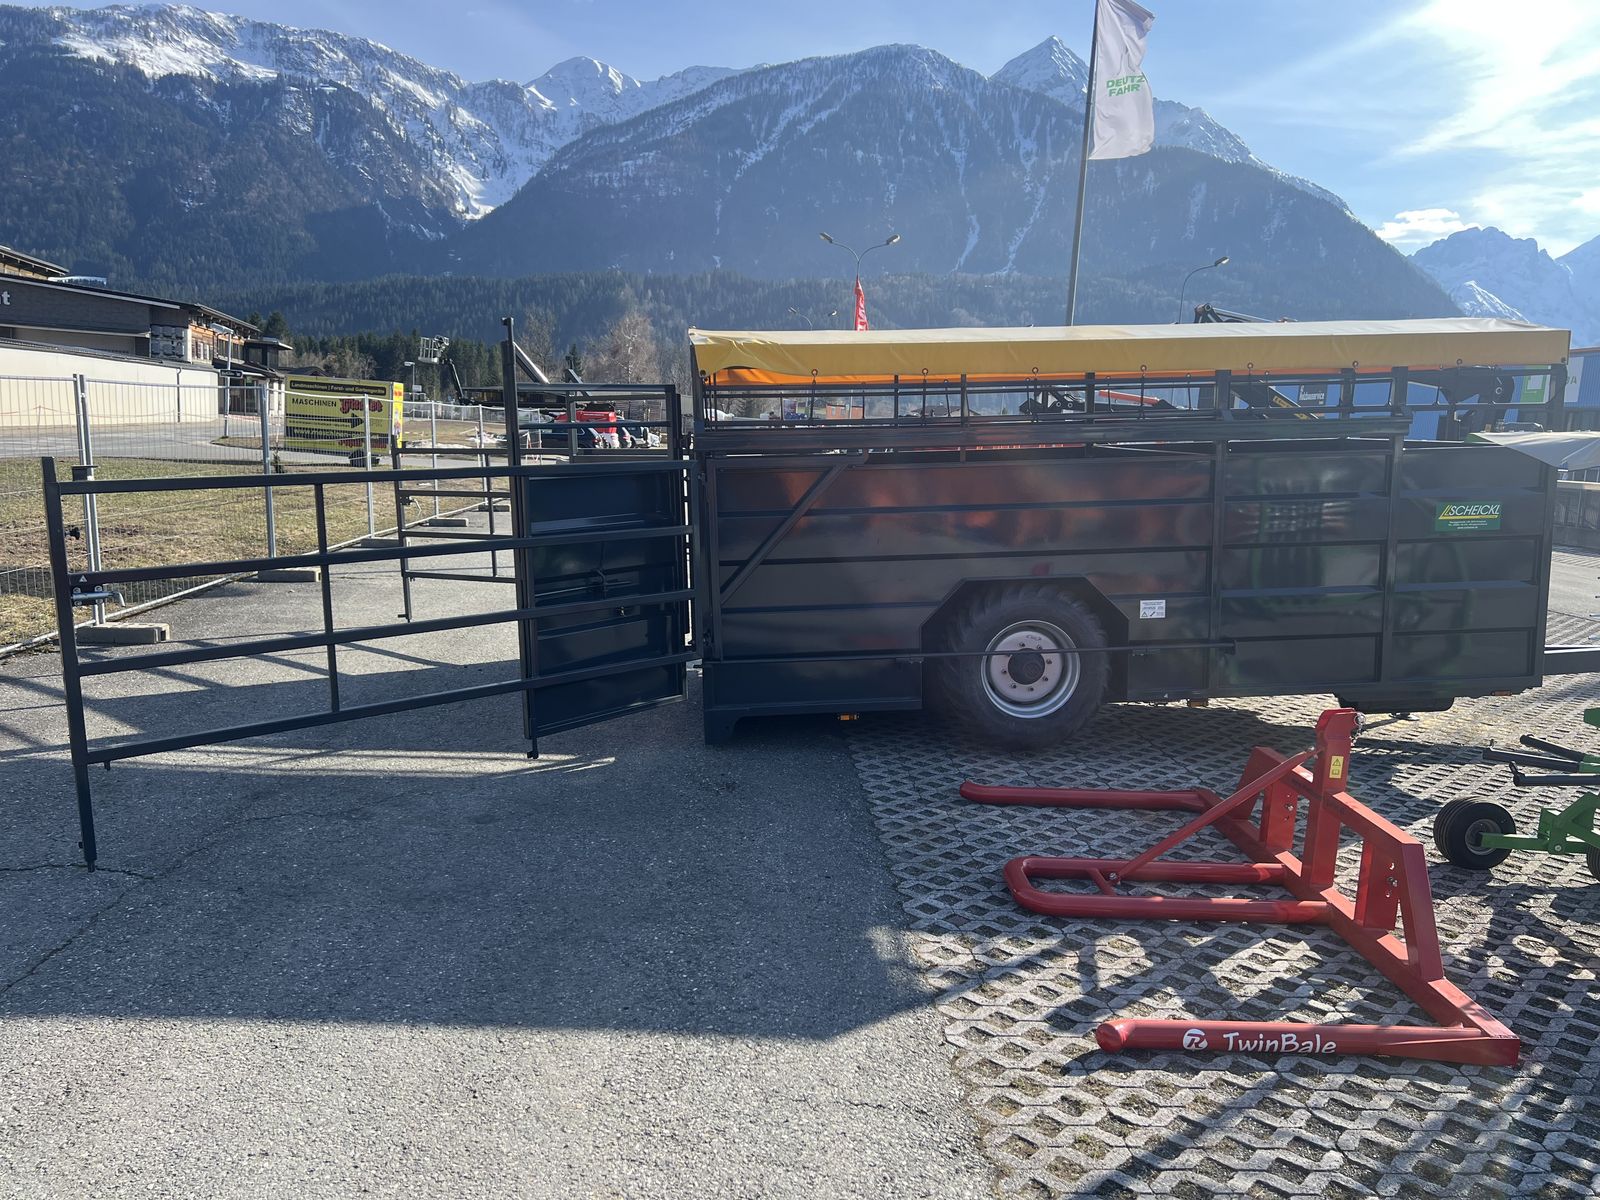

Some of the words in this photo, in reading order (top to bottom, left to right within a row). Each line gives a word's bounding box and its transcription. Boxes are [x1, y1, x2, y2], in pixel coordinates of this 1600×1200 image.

[1106, 75, 1145, 88] DEUTZ
[1108, 84, 1140, 97] FAHR
[291, 398, 337, 407] MASCHINEN
[1448, 504, 1500, 516] SCHEICKL
[1223, 1031, 1337, 1054] TwinBale
